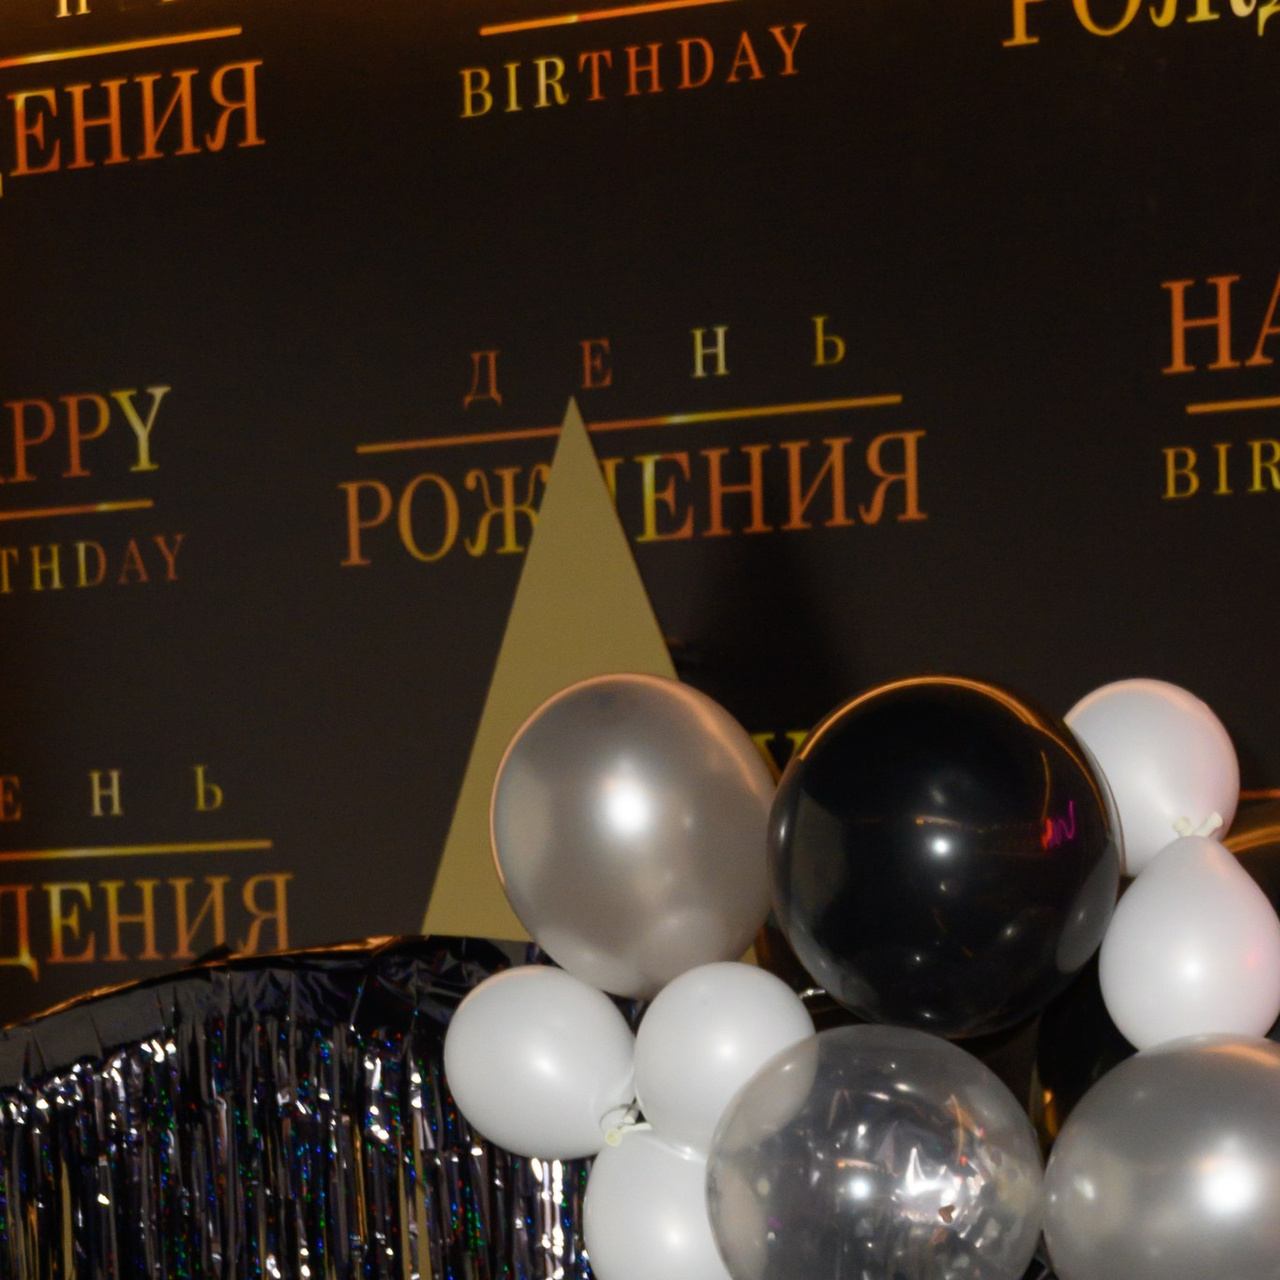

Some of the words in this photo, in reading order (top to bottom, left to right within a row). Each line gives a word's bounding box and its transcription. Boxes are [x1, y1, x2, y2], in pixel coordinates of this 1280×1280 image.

[0, 59, 266, 178] ЕНИЯ
[458, 22, 808, 119] BIRTHDAY
[0, 386, 172, 484] PPY
[338, 430, 928, 566] РОЖЕНИЯ
